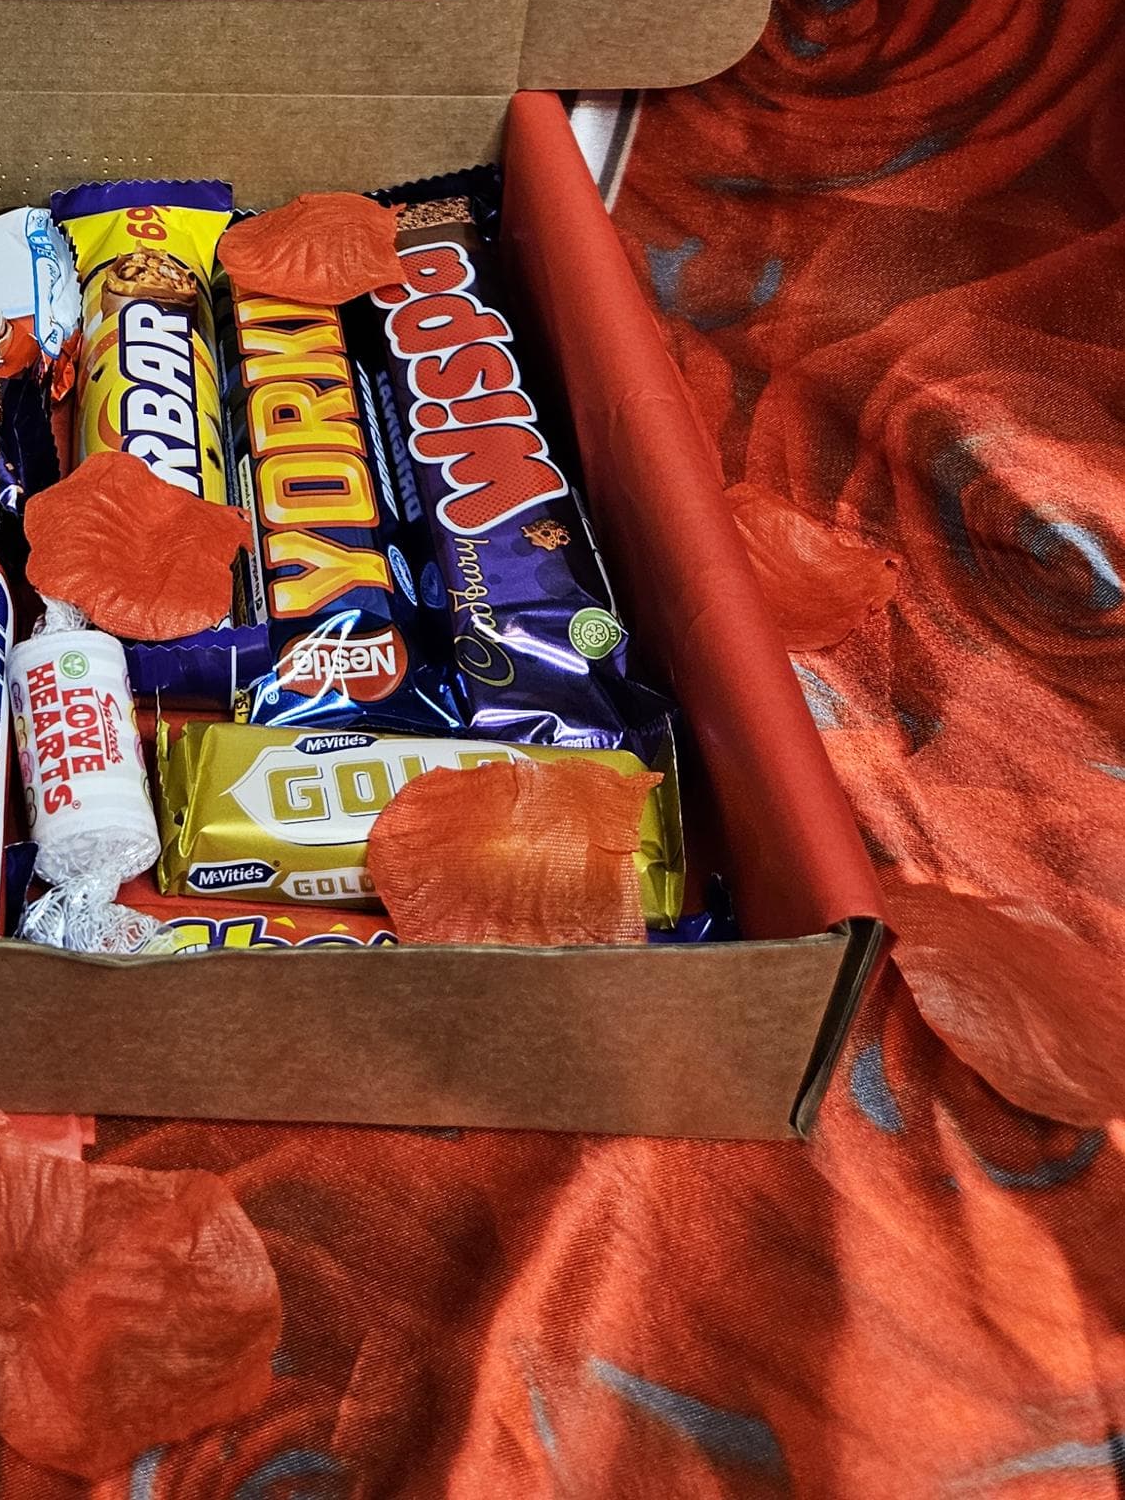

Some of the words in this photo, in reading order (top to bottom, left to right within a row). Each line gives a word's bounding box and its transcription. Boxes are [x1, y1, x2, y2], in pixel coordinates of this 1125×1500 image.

[235, 286, 395, 619] YORKI
[370, 242, 568, 534] Wispa
[448, 537, 515, 687] Cadbury
[573, 622, 587, 650] COCOA
[26, 661, 73, 815] HEARTS
[61, 687, 106, 774] LOVE
